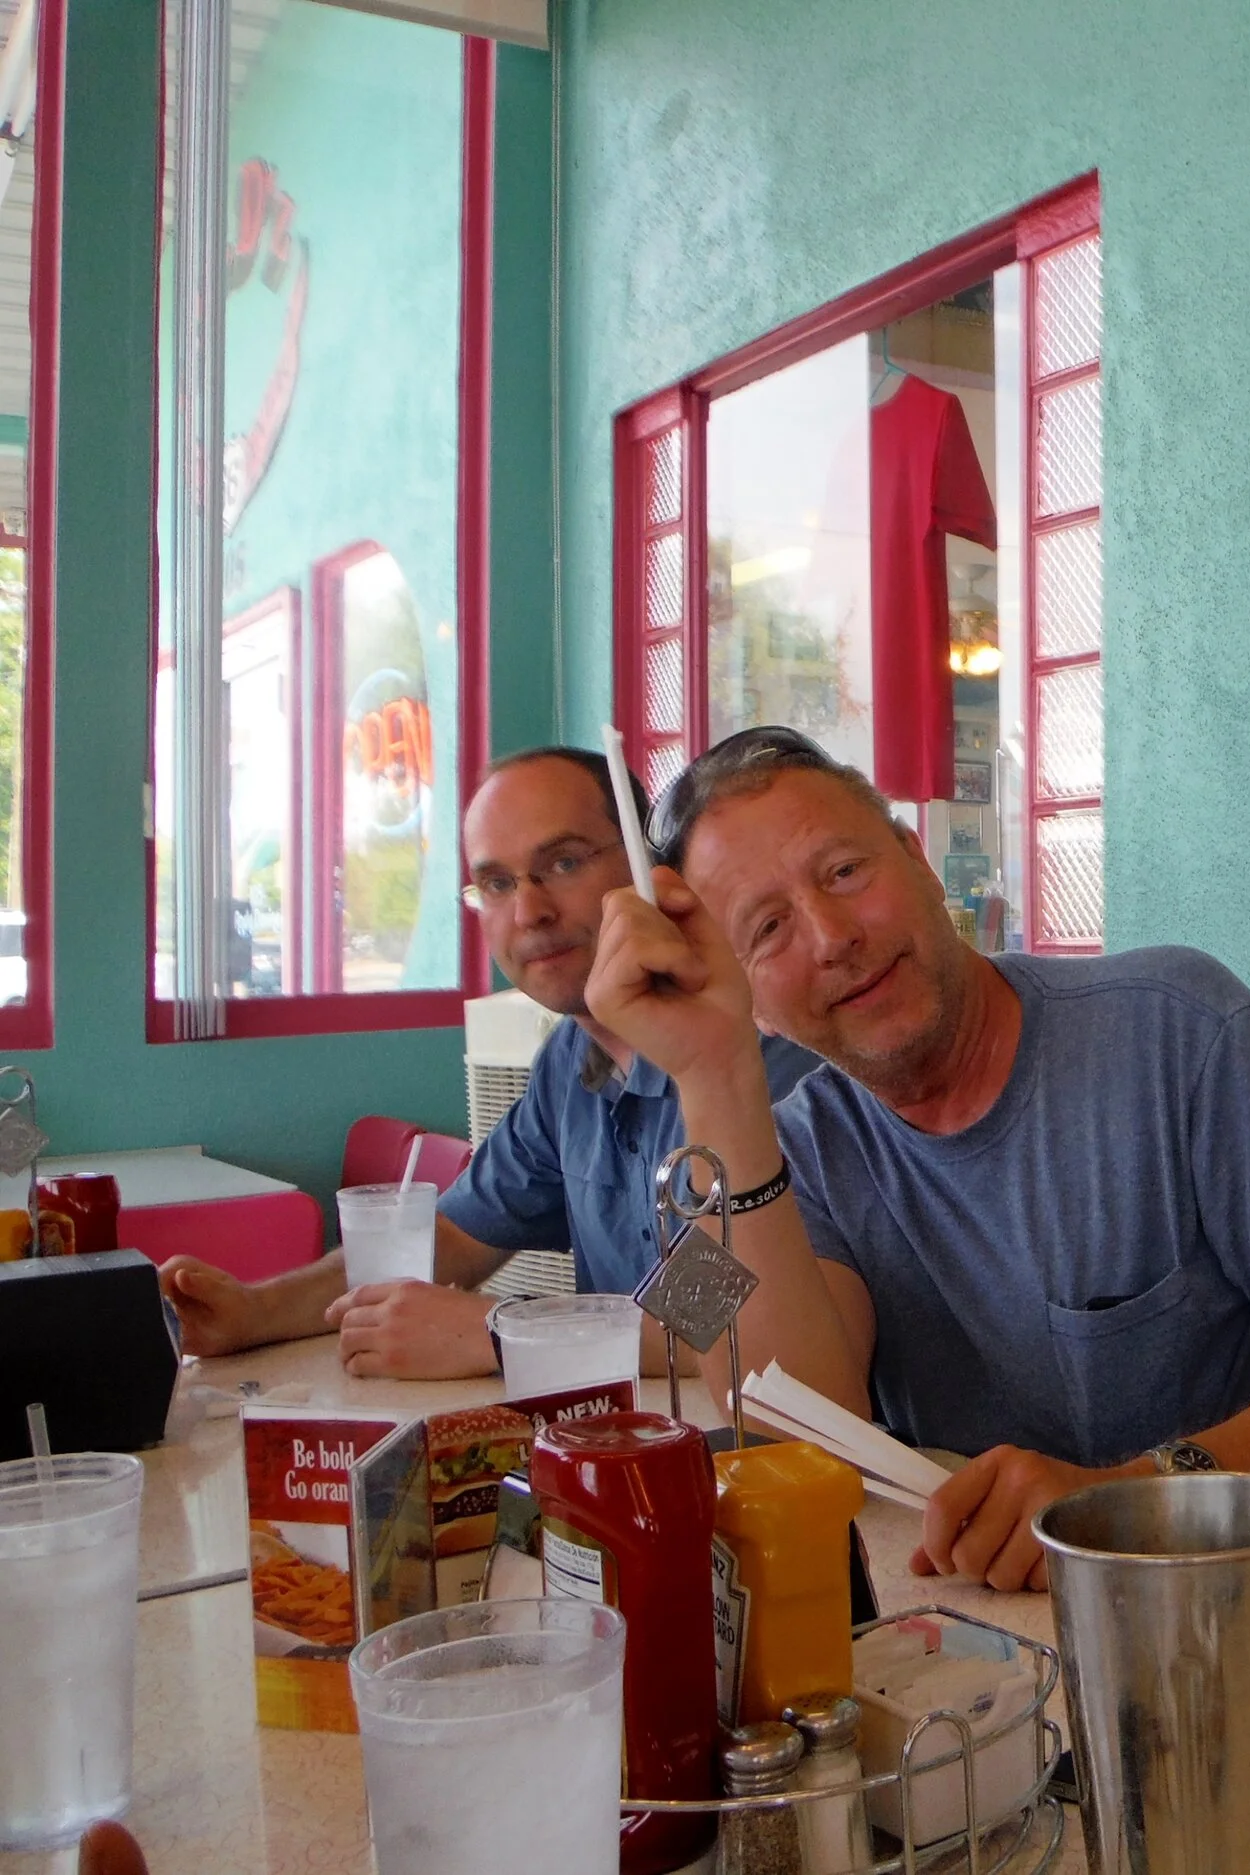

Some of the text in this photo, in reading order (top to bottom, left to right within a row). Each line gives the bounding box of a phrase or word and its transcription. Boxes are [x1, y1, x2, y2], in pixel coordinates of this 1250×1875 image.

[293, 1439, 355, 1471] Be bold
[284, 1470, 349, 1502] Go oran
